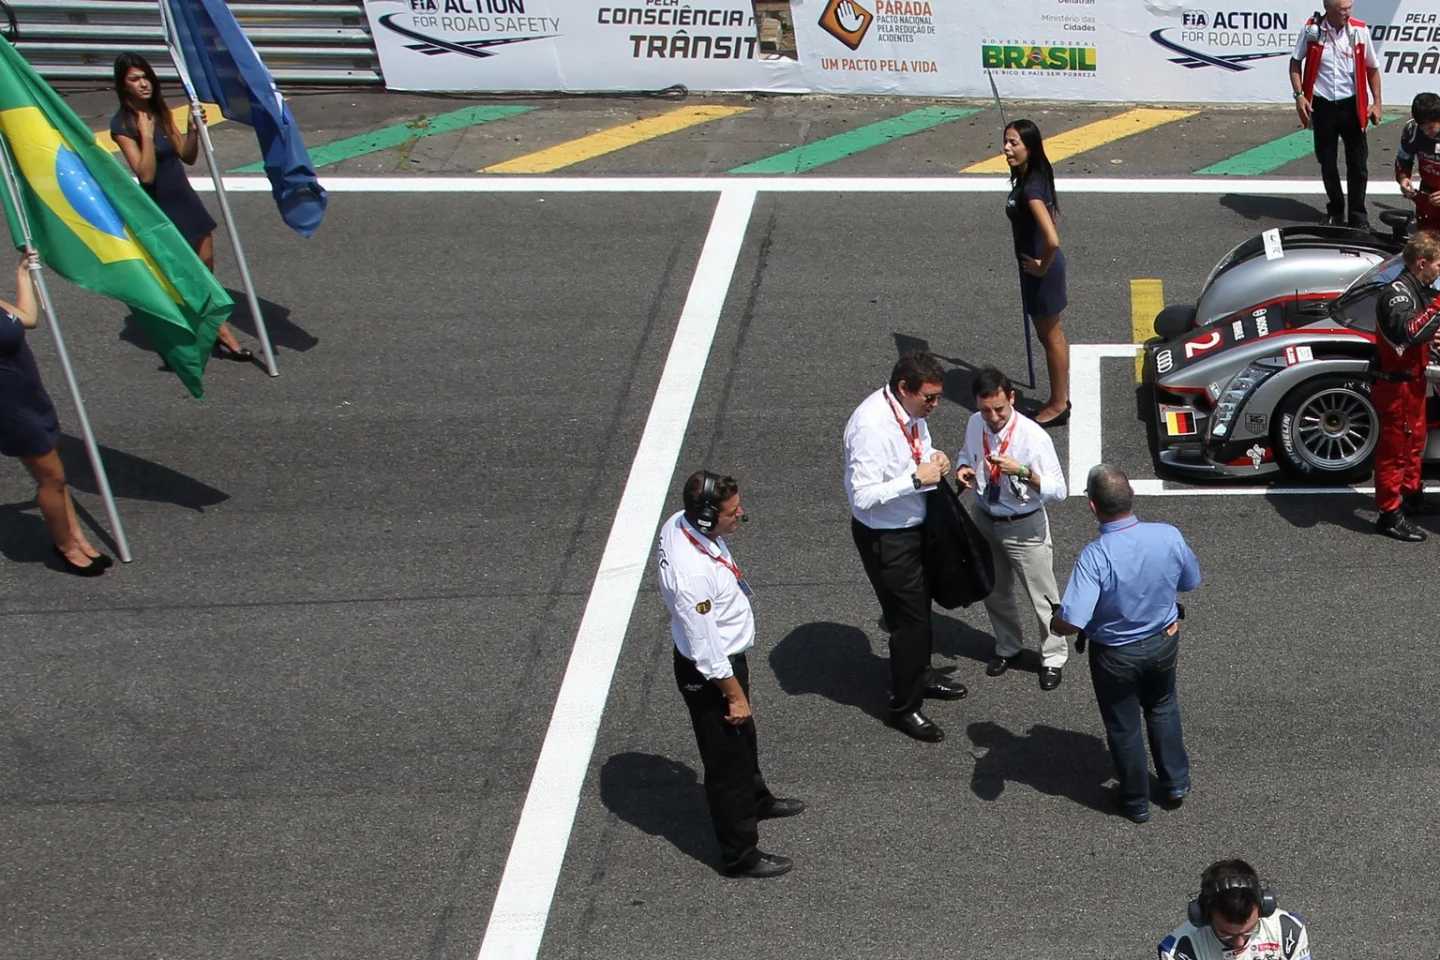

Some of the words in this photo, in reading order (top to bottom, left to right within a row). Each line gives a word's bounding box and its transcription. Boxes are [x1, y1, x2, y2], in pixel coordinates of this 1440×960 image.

[444, 0, 526, 15] ACTION
[875, 0, 933, 17] PARADA
[597, 5, 744, 27] CONSCIÊNCIA
[876, 15, 898, 25] PACTO
[899, 16, 933, 26] NACIONAL
[1075, 15, 1096, 23] das
[1213, 12, 1288, 30] ACTION
[1405, 13, 1437, 24] PELA
[412, 16, 439, 29] FOR
[442, 17, 492, 32] ROAD
[494, 17, 561, 33] SAFETY
[877, 25, 895, 34] PELA
[927, 26, 936, 35] DE
[1063, 23, 1097, 32] Cidades
[629, 29, 759, 60] TRÂNSIT
[878, 33, 915, 43] ACIDENTES
[1182, 31, 1205, 42] FOR
[1208, 32, 1252, 47] ROAD
[1256, 33, 1297, 47] SAFE
[821, 58, 840, 71] UM
[841, 59, 877, 72] PACTO
[880, 60, 909, 73] PELA
[910, 60, 939, 74] VIDA
[982, 45, 1097, 72] BRASIL
[1255, 316, 1269, 337] BOSCH
[1184, 331, 1221, 359] 2
[1281, 415, 1312, 473] MICHELIN
